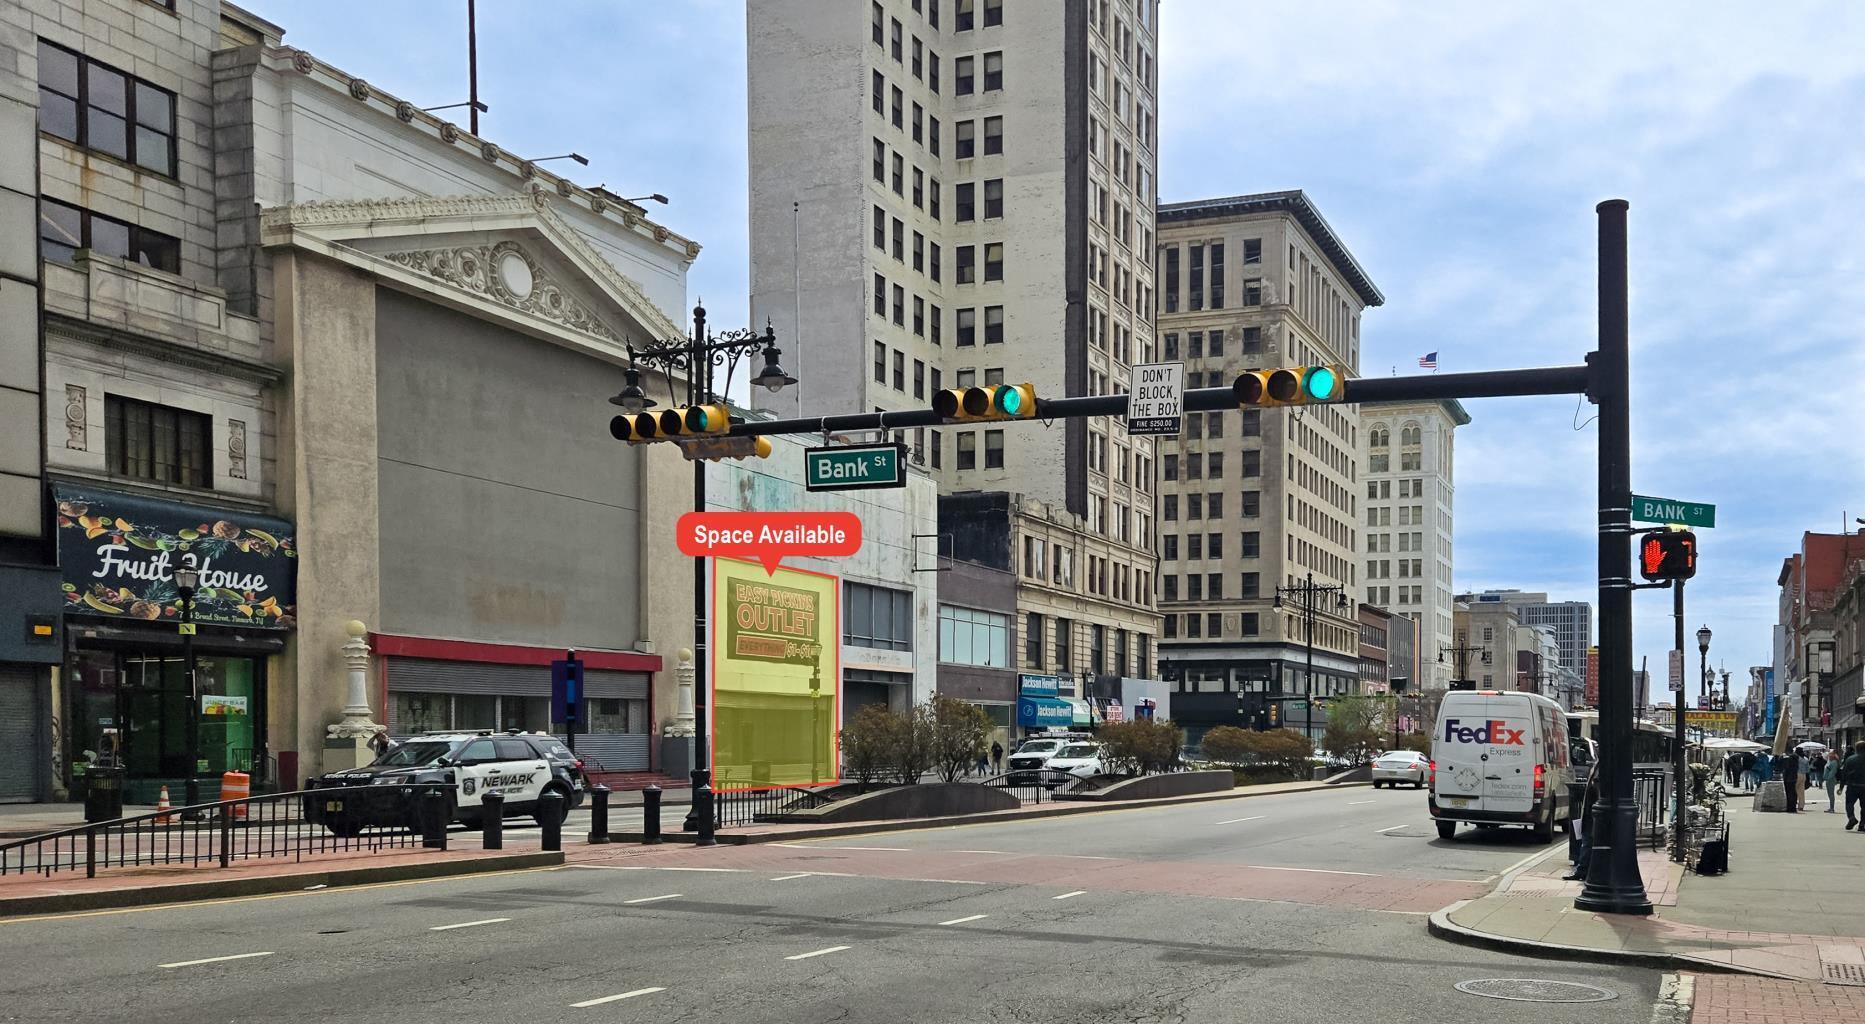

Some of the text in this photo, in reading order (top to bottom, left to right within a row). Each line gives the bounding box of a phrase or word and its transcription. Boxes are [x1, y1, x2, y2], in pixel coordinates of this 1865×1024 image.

[1142, 368, 1173, 383] DON'T
[1139, 385, 1173, 400] BLOCK
[1132, 402, 1178, 417] THE BOX
[1149, 419, 1173, 427] $250.00
[818, 455, 886, 479] Bank St
[1643, 503, 1704, 520] BANK ST
[92, 544, 173, 582] Fruit
[736, 583, 814, 611] EASY PICKINS
[736, 602, 815, 636] OUTLET
[1022, 675, 1042, 689] Jackson
[1041, 677, 1057, 690] Hewitt
[1037, 702, 1072, 717] Jackson Hewitt
[1445, 719, 1525, 745] FedEx
[1489, 747, 1521, 757] Express
[481, 772, 537, 788] NEWARK
